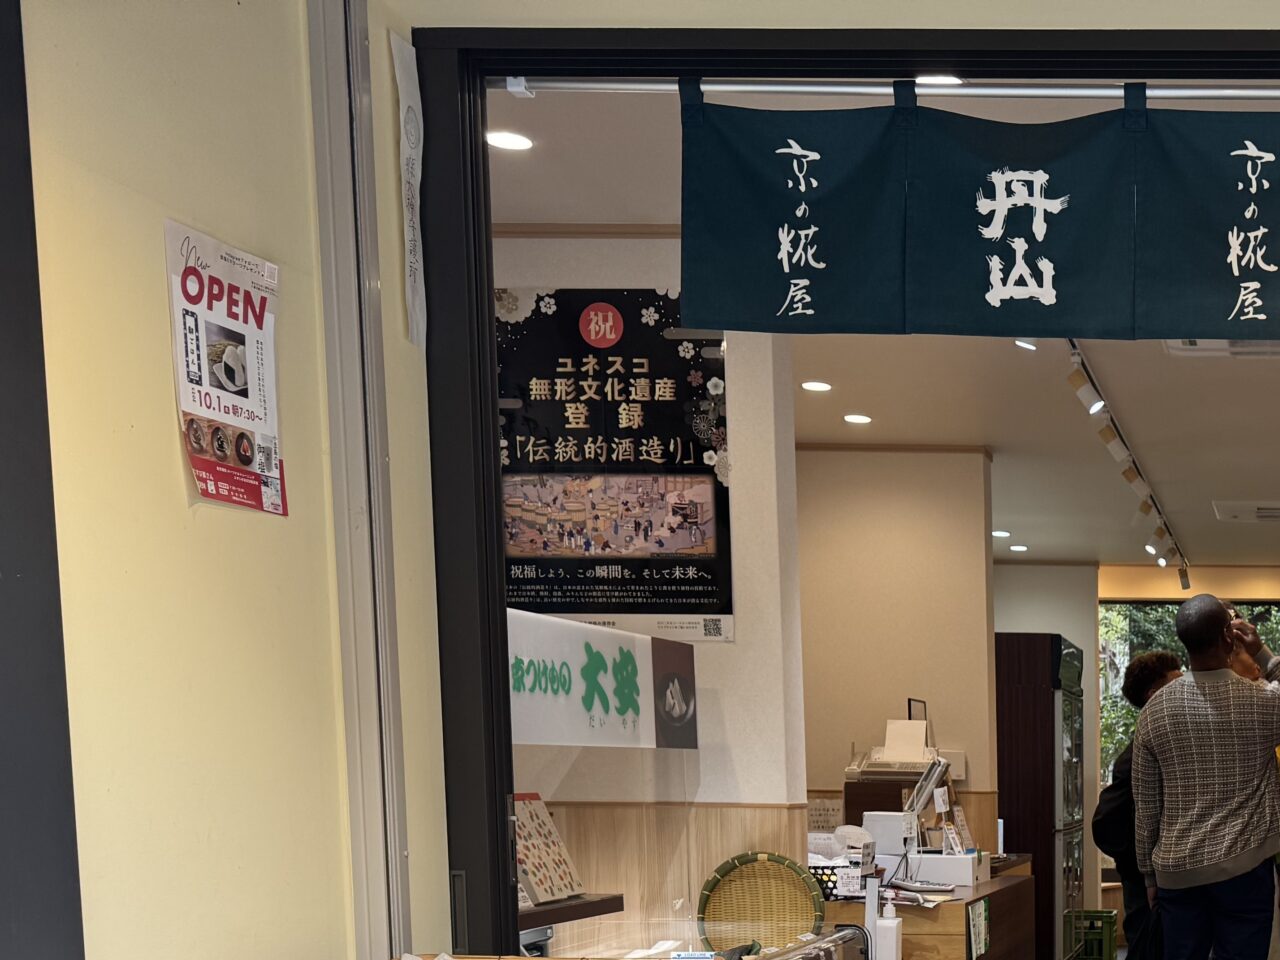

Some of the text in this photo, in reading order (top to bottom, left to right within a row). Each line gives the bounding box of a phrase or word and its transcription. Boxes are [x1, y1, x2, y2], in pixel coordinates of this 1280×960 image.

[976, 166, 1070, 308] 丹山
[181, 266, 268, 331] OPEN
[587, 311, 616, 340] 祝
[556, 355, 650, 374] ユネスコ
[529, 378, 677, 400] 無形文化遺産
[516, 436, 695, 465] 「伝統的酒造り」
